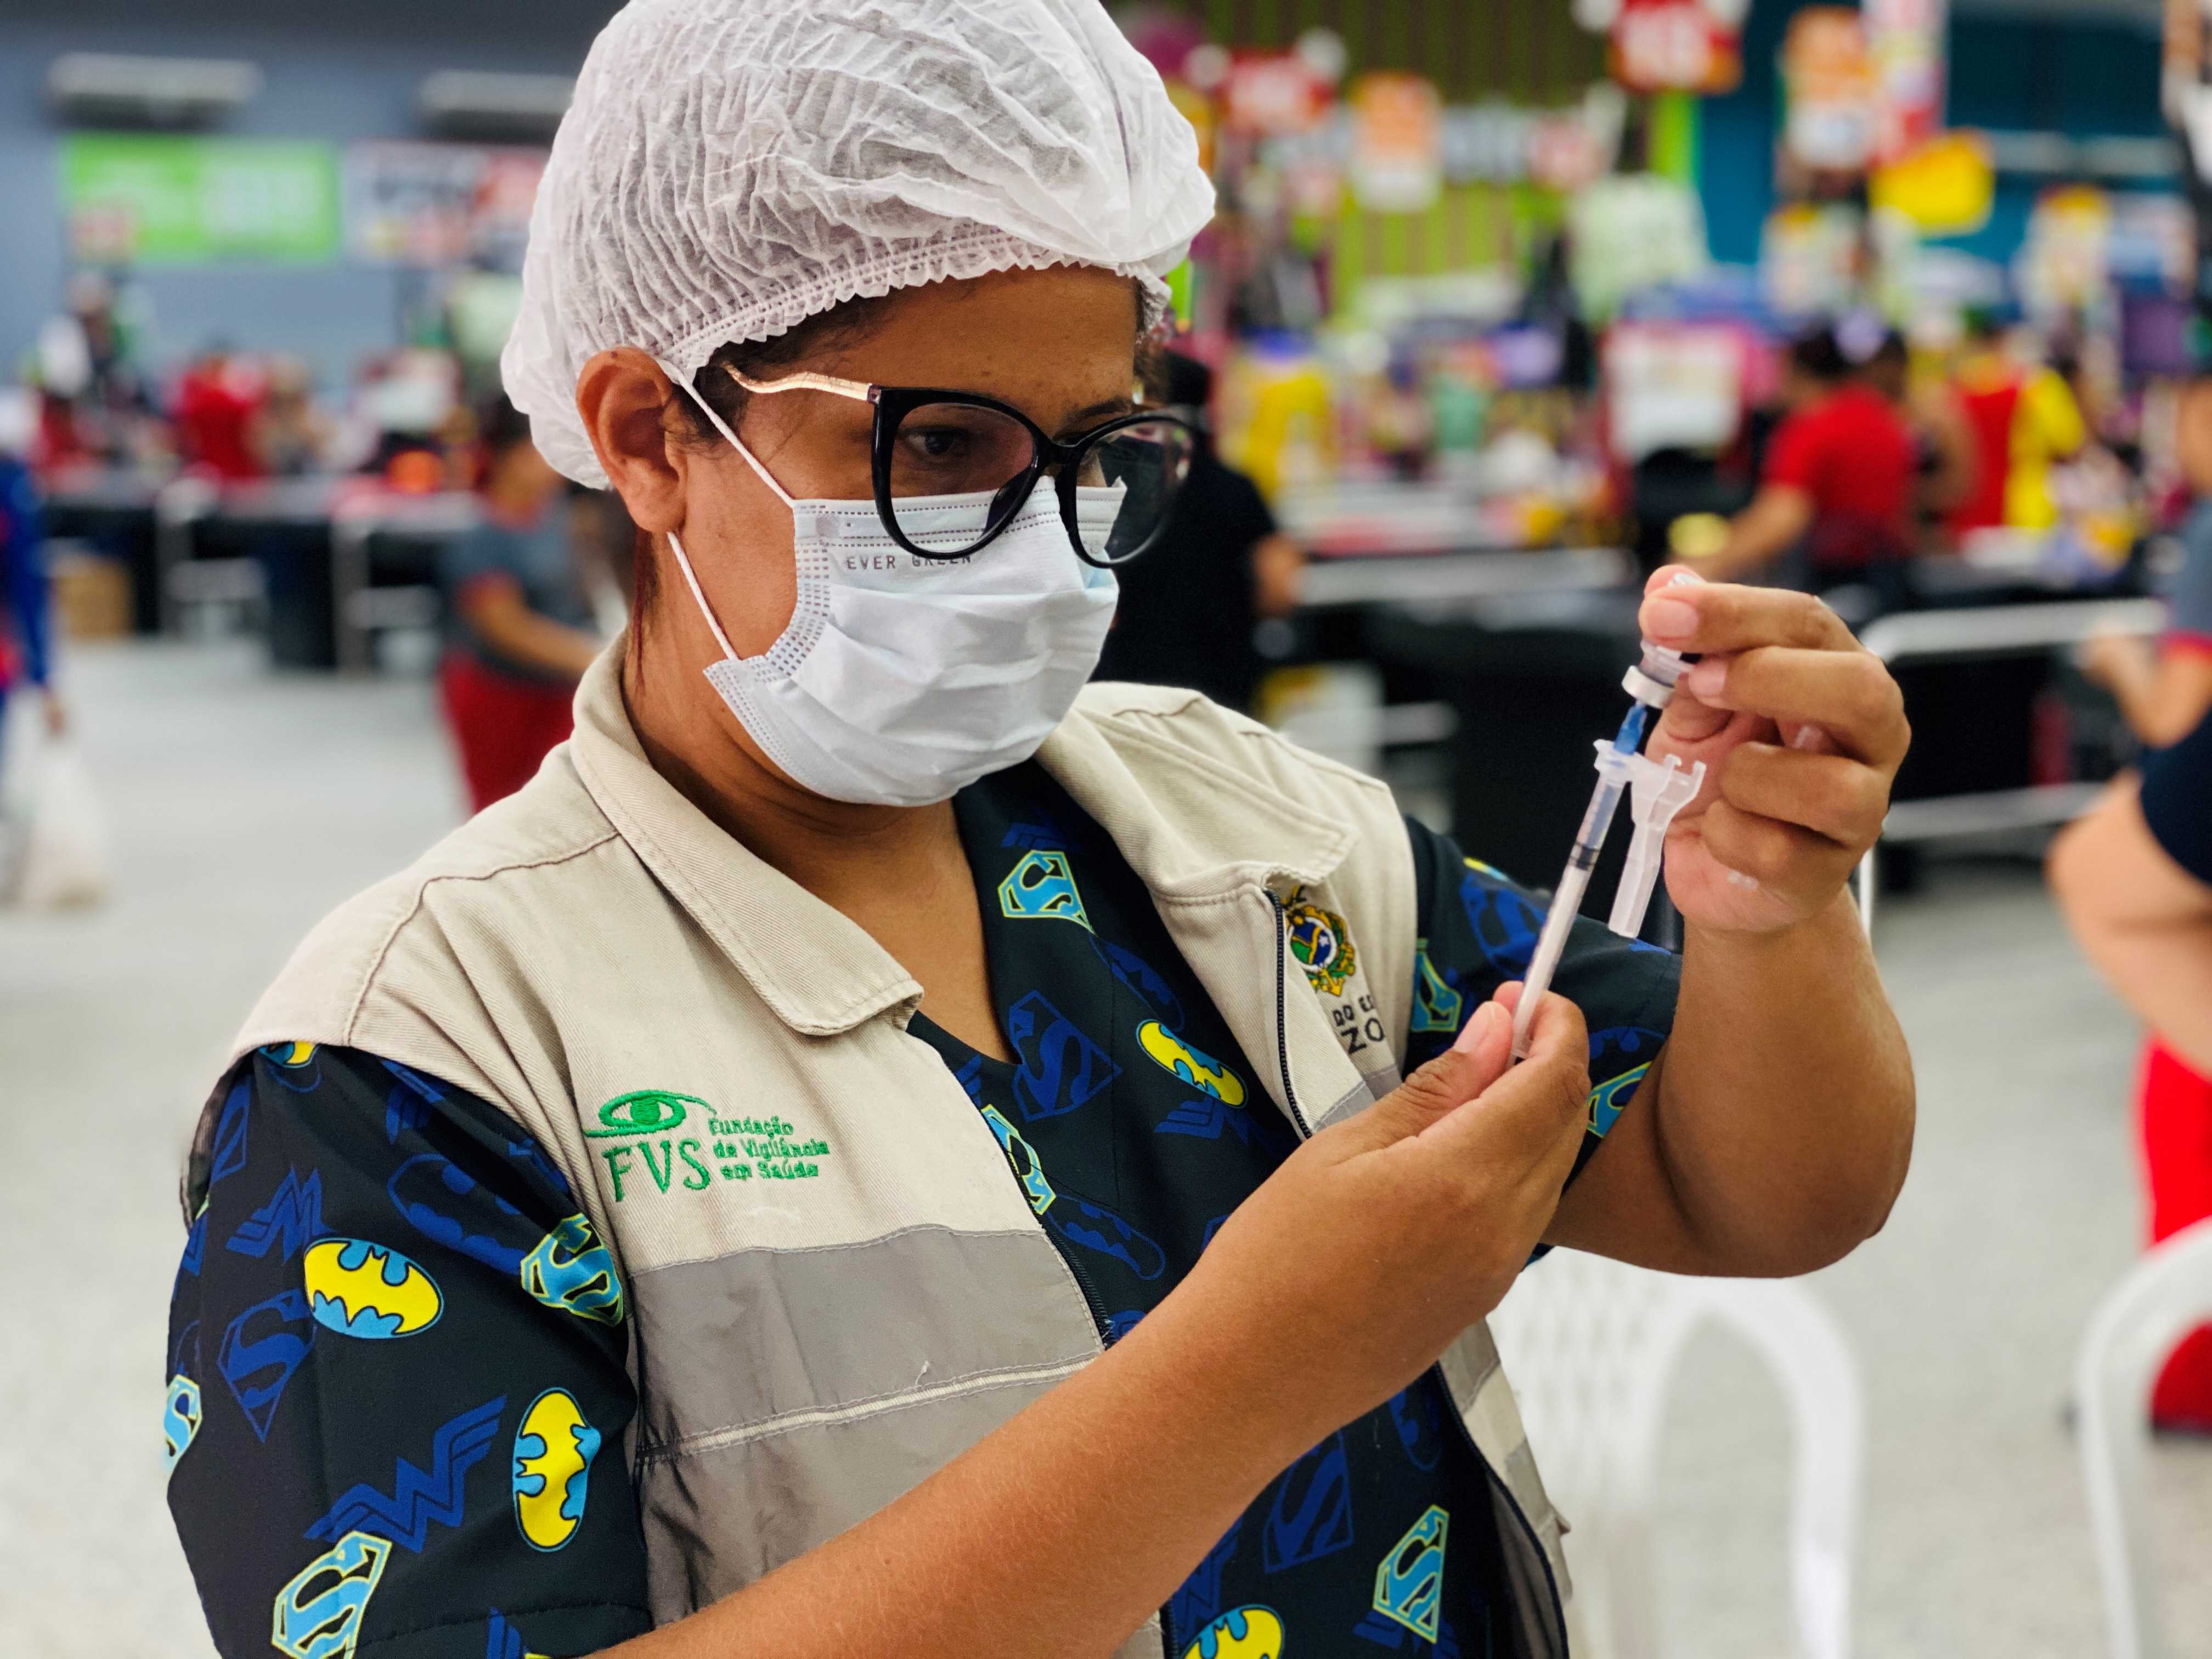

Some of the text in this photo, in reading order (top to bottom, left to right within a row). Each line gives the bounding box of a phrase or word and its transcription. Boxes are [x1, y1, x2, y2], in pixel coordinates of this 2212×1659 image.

[847, 555, 895, 570] EVER
[1332, 1005, 1355, 1026] DO
[1340, 1017, 1385, 1054] ZO
[708, 1115, 794, 1138] Fundação
[713, 1139, 737, 1159] de
[601, 1138, 710, 1203] FVS
[720, 1159, 819, 1181] em Saúde
